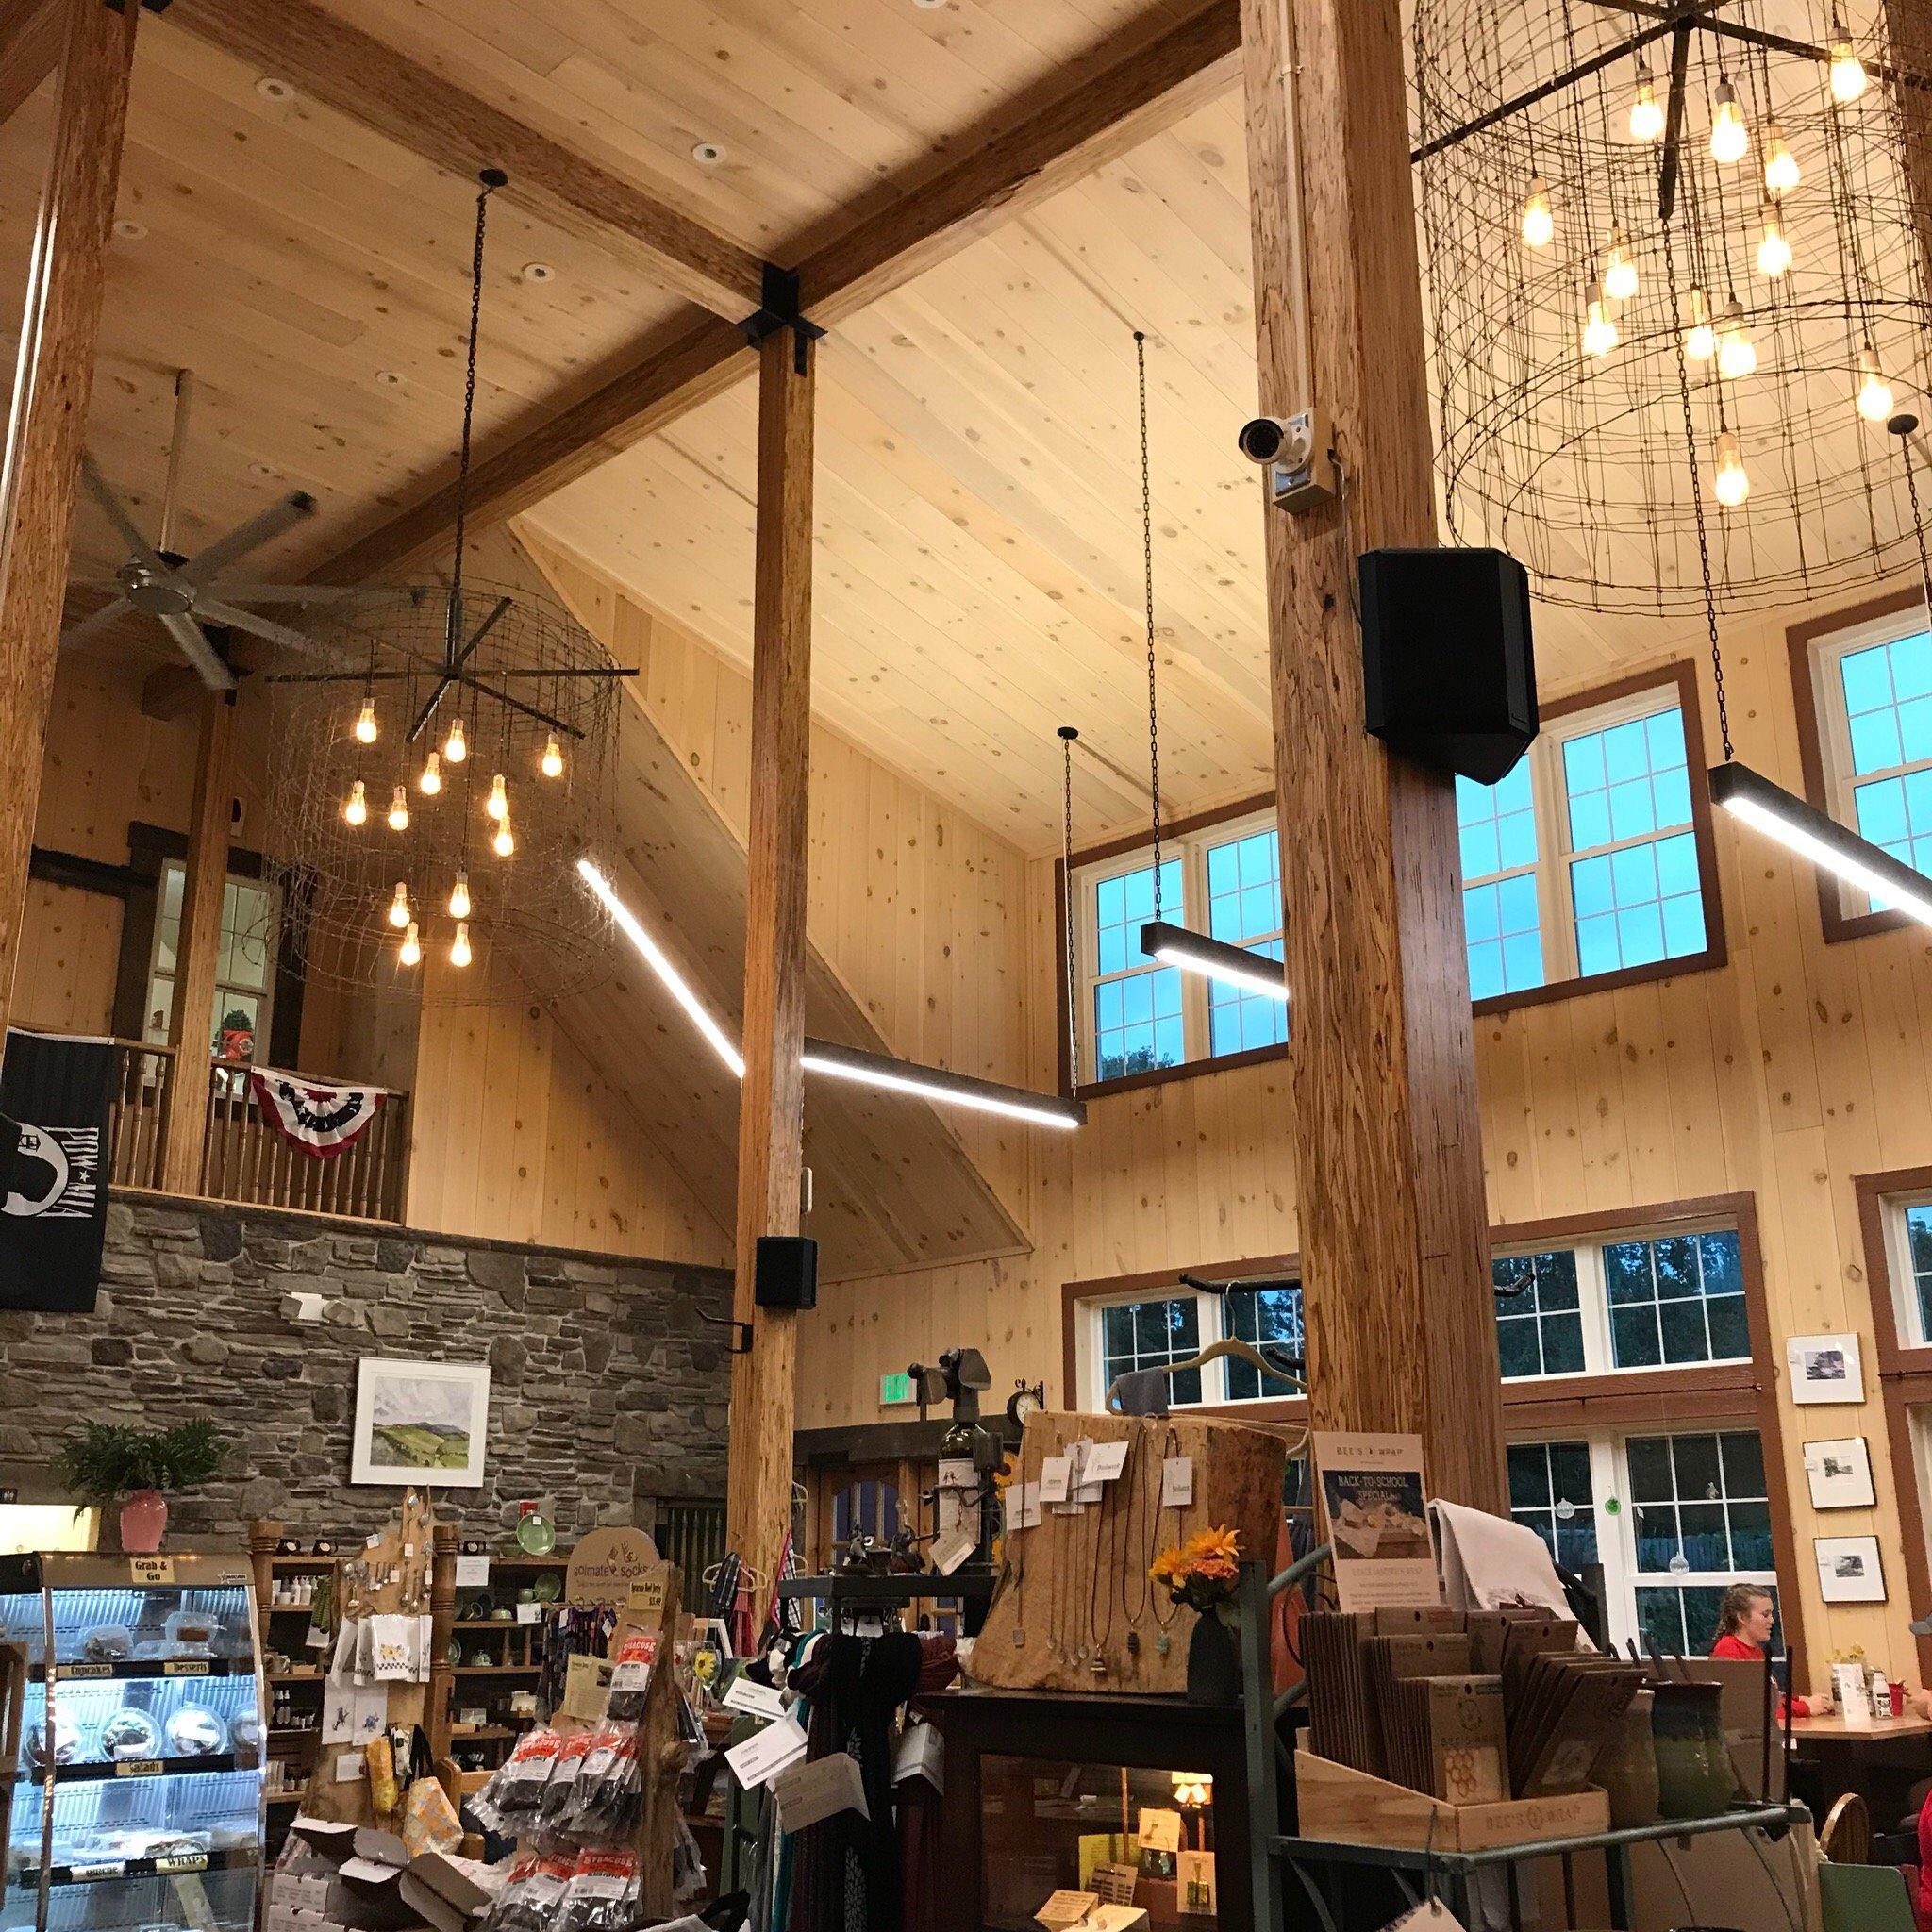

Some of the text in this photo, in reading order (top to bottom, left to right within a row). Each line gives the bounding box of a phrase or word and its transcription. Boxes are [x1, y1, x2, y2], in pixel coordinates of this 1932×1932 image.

[36, 1125, 99, 1218] POW MIA
[1337, 1474, 1409, 1488] BACK-TO-SCHOOL
[135, 1560, 167, 1571] Grab &
[573, 1565, 609, 1577] solmate
[146, 1572, 161, 1581] Go
[70, 1665, 111, 1676] Cupcakes
[173, 1661, 208, 1673] Desserts
[128, 1760, 160, 1773] Salads
[167, 1855, 205, 1867] WRAPS
[584, 1855, 634, 1867] SYRACUSE
